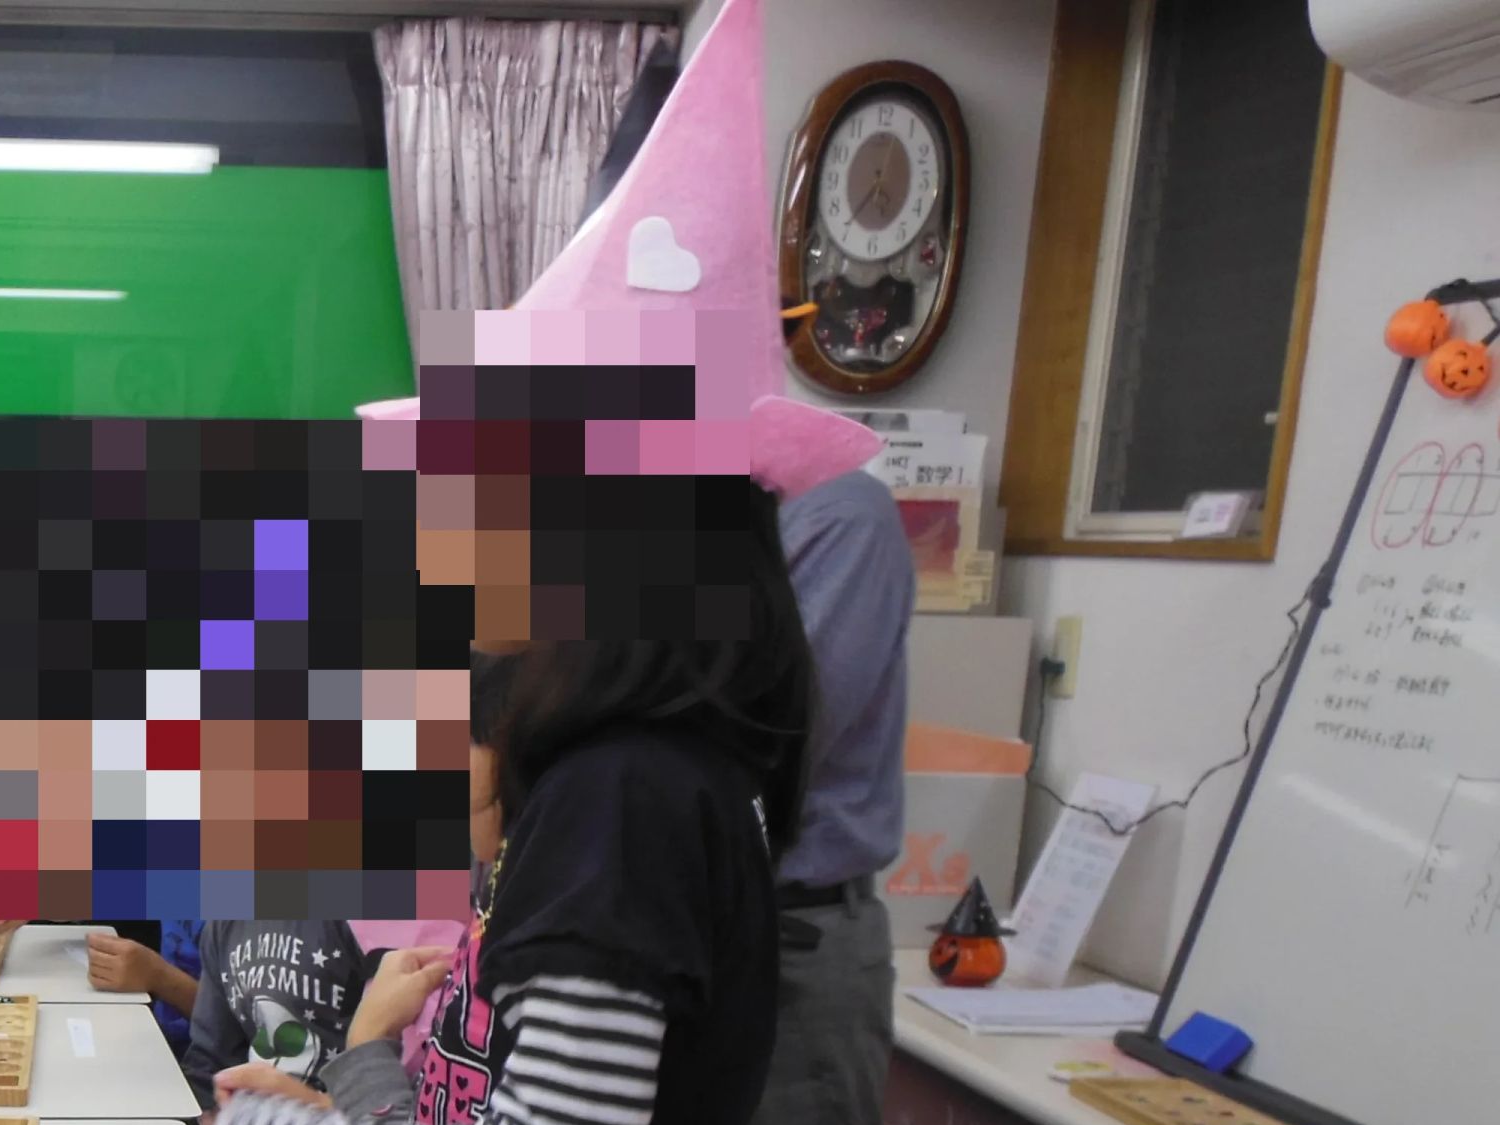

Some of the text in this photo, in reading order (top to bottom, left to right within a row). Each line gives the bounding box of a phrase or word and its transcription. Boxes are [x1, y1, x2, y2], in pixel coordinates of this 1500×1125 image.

[877, 105, 894, 126] 12
[851, 118, 863, 139] 11
[911, 118, 915, 138] 1
[829, 197, 840, 217] 8
[867, 233, 878, 256] 6
[256, 932, 304, 966] MINE
